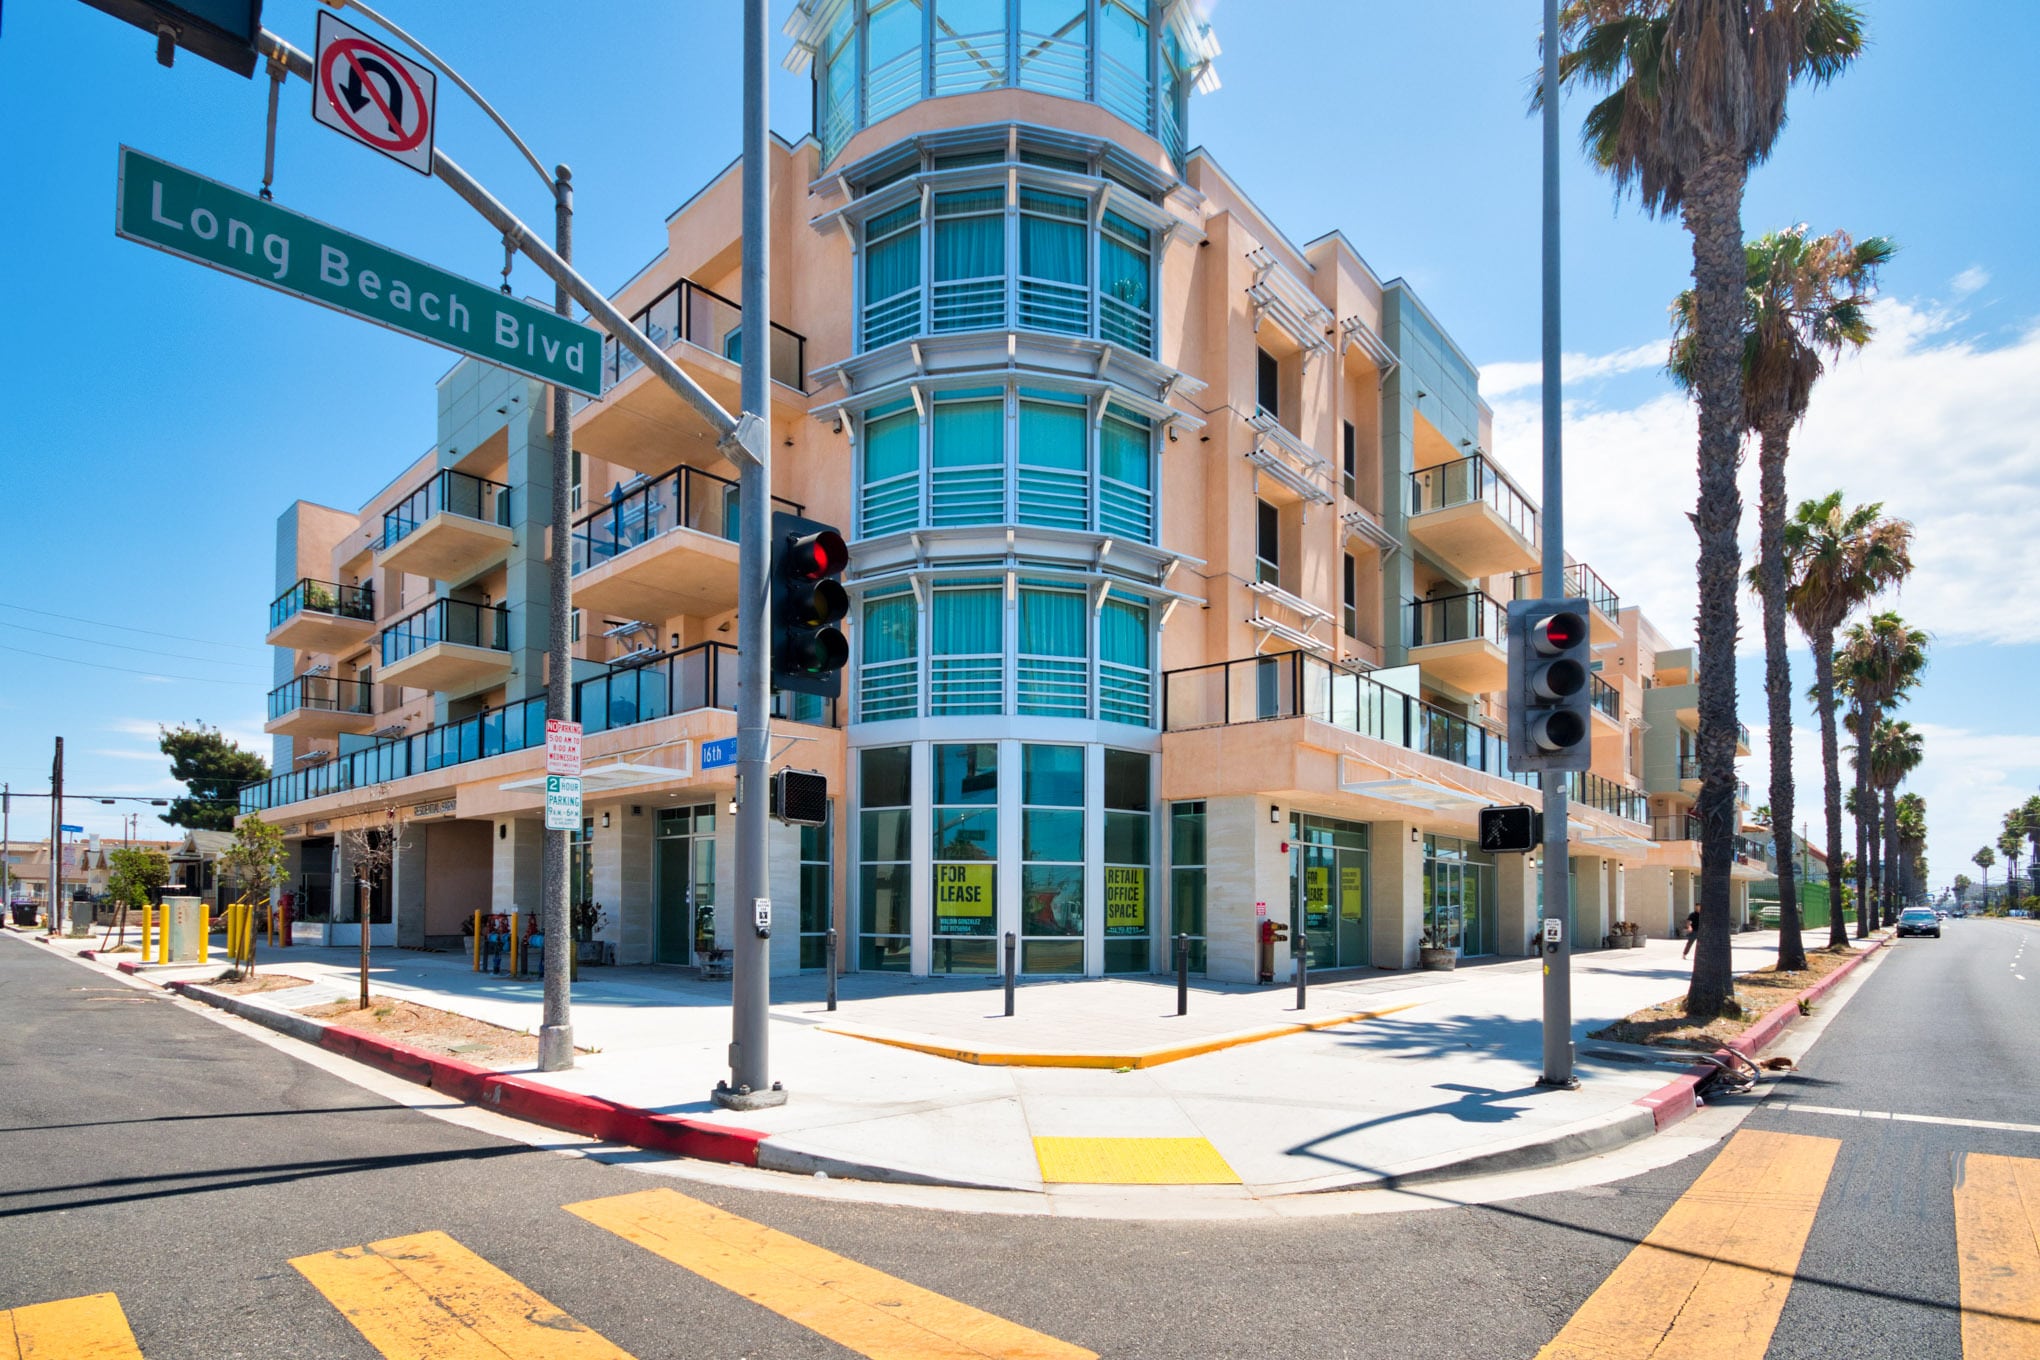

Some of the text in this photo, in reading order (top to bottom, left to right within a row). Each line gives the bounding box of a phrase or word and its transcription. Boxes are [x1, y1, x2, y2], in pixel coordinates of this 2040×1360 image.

[152, 180, 584, 375] Long Beach Blvd
[548, 720, 581, 734] NO PARKING
[549, 752, 579, 761] WEDNESDAY
[703, 745, 722, 763] 16th
[549, 777, 579, 791] 2 HOUR
[549, 795, 580, 807] PARKING
[941, 865, 966, 882] FOR
[1108, 869, 1139, 884] RETAIL
[1307, 871, 1318, 885] FOR
[941, 885, 982, 902] LEASE
[1108, 886, 1139, 901] OFFICE
[1108, 903, 1138, 918] SPACE
